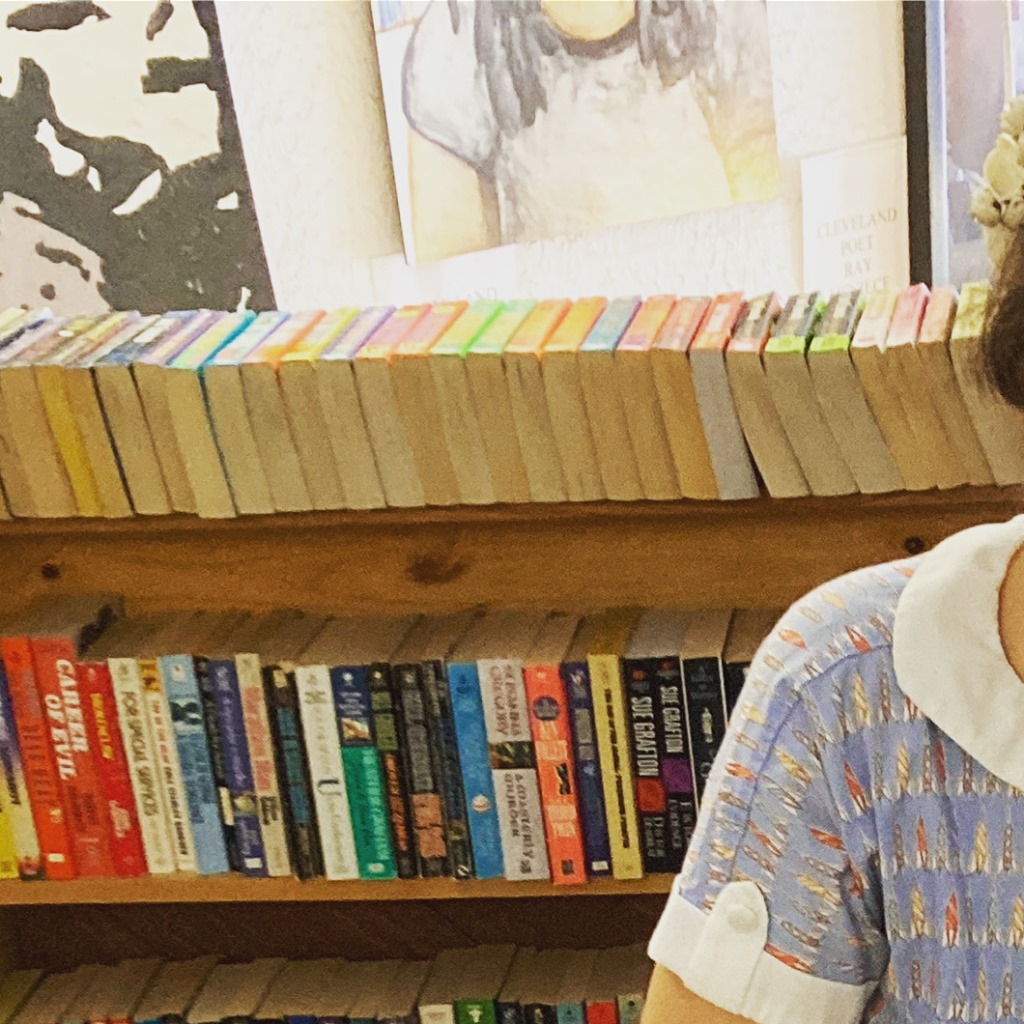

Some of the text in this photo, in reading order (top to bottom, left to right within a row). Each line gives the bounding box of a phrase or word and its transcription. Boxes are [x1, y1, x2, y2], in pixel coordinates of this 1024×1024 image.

[817, 207, 898, 240] CLEVELAND
[840, 234, 874, 258] POET
[845, 258, 873, 278] RAY
[43, 692, 76, 781] OF EVIL
[55, 657, 89, 754] CAREER
[630, 695, 658, 777] SUE GRAFTON
[659, 685, 683, 753] SUE GRAFTON
